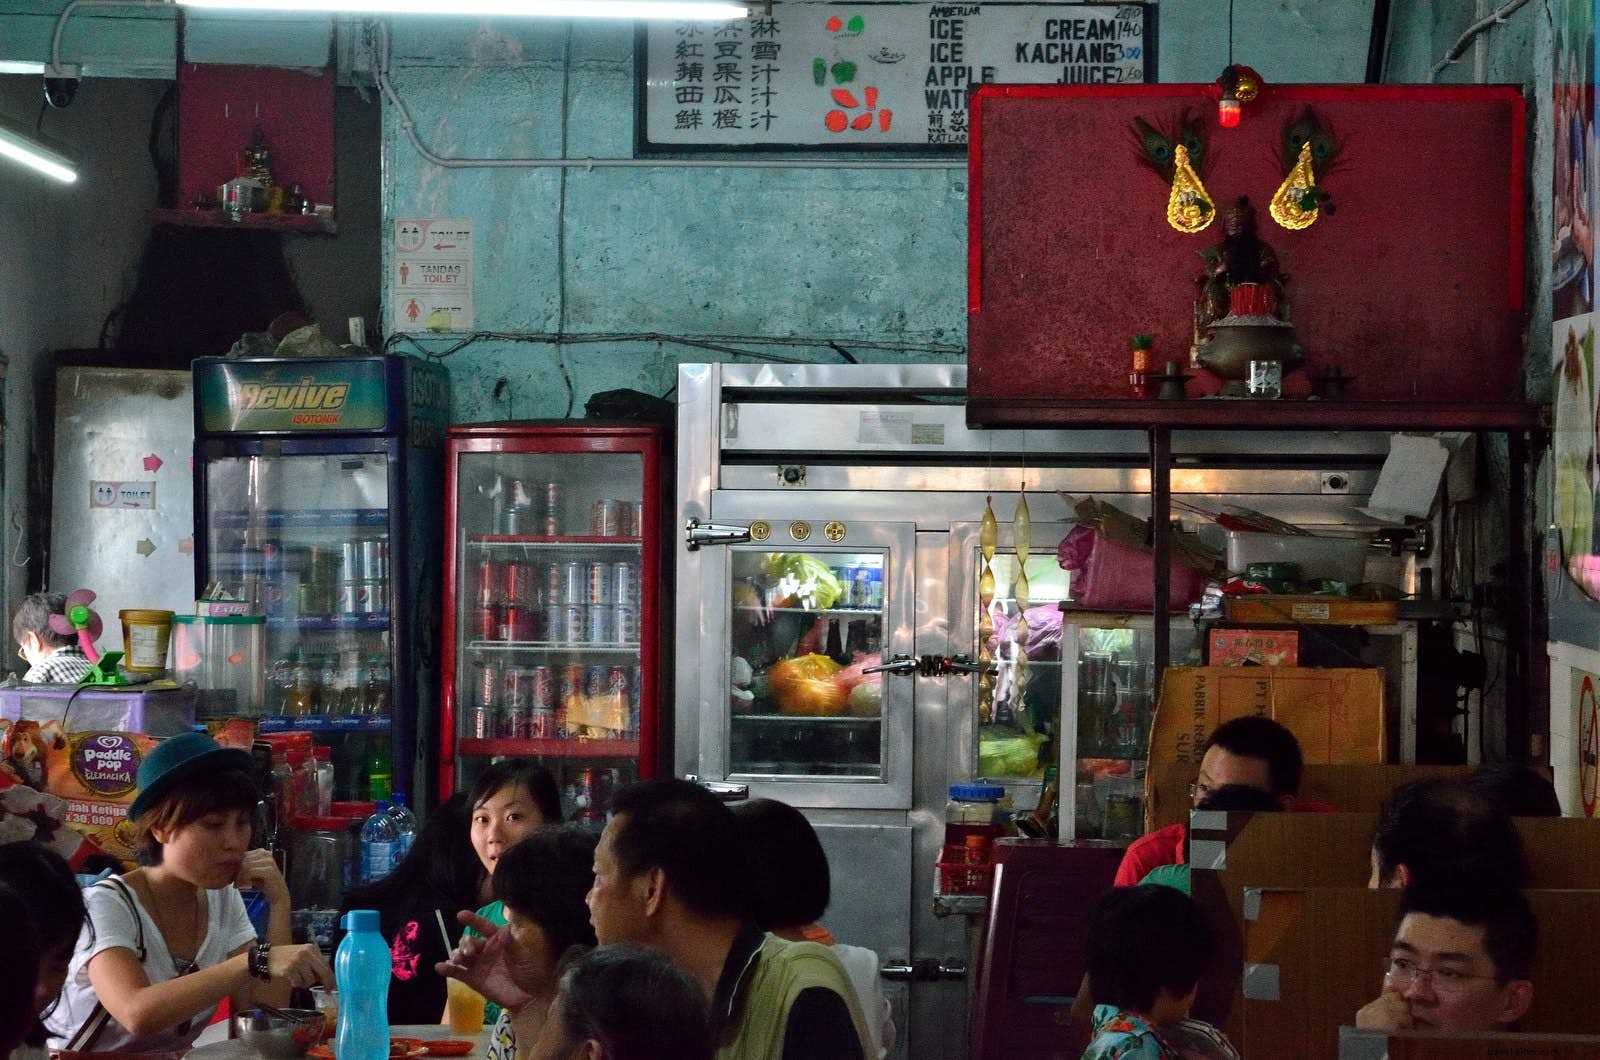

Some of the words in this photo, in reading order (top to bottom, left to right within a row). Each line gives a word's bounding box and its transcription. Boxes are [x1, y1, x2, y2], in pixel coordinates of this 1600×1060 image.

[930, 19, 965, 40] ICE
[1045, 19, 1115, 40] CREAM
[674, 40, 782, 60] 紅豆雪
[930, 43, 964, 63] ICE
[1015, 42, 1116, 64] KACHANG
[925, 66, 995, 86] APPLE
[1057, 66, 1115, 84] JUICE
[675, 85, 779, 107] 西瓜汁
[674, 108, 779, 131] 鮮橙汁
[420, 265, 461, 274] TANDAS
[423, 274, 458, 283] TOILET
[240, 376, 349, 410] Revive
[291, 413, 339, 425] ISOTONIK
[92, 805, 127, 817] Ketiga
